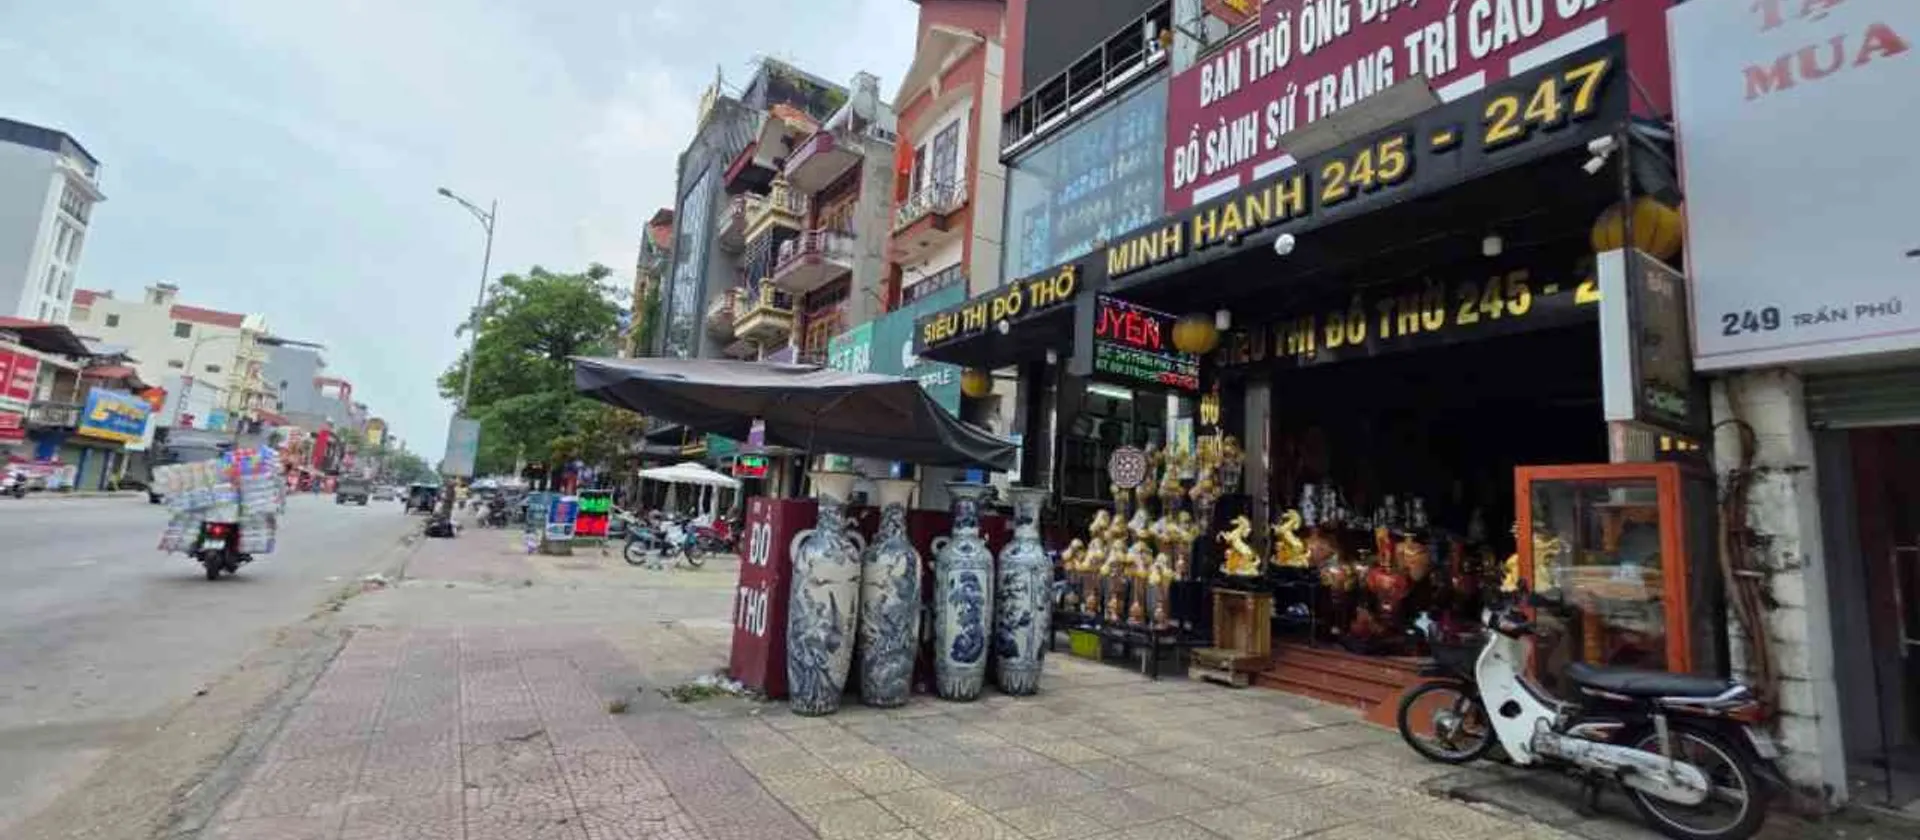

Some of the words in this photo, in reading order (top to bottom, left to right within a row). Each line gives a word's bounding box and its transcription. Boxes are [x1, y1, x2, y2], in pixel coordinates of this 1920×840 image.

[1247, 10, 1292, 83] THỜ
[1742, 20, 1911, 101] MUA
[1173, 122, 1200, 190] ĐỒ
[1204, 110, 1259, 176] SÀNH
[1265, 81, 1298, 150] SỨ
[1304, 45, 1394, 124] TRANG
[1404, 0, 1458, 79] TRÍ
[1107, 221, 1184, 277] MINH
[1193, 173, 1306, 245] HẠNH
[1321, 135, 1408, 202] 245
[1432, 130, 1451, 146] -
[1485, 56, 1609, 145] 247
[923, 312, 958, 344] SIÊU
[963, 302, 988, 333] THỊ
[992, 280, 1022, 320] ĐỒ
[1030, 264, 1076, 308] THỜ
[1456, 269, 1533, 325] 245
[1721, 306, 1781, 337] 249
[1855, 297, 1903, 320] PHÚ
